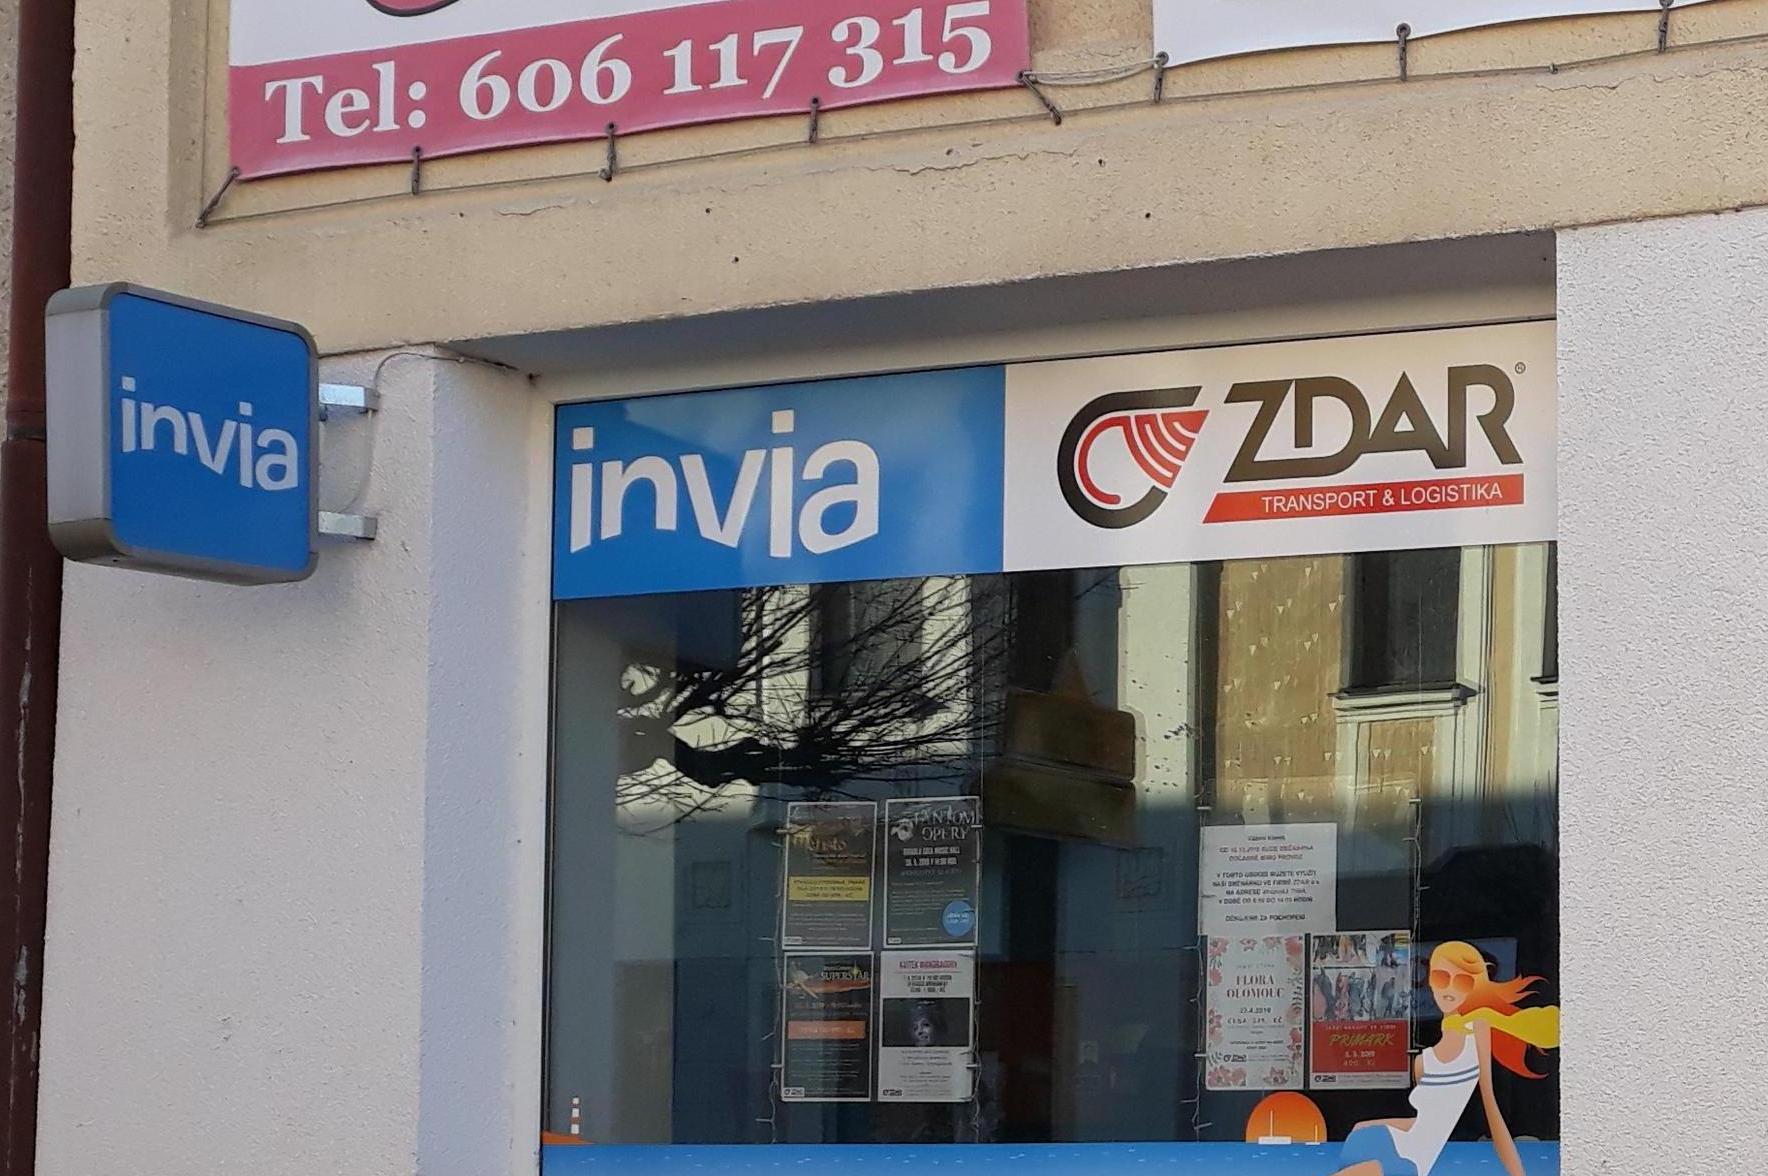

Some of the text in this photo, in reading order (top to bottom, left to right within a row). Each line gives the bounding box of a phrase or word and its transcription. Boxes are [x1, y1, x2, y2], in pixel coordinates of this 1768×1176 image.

[265, 1, 993, 144] Tel: 606 117 315
[120, 375, 299, 493] invia
[568, 408, 881, 559] invia
[1262, 482, 1503, 513] TRANSPORT & LOGISTIKA
